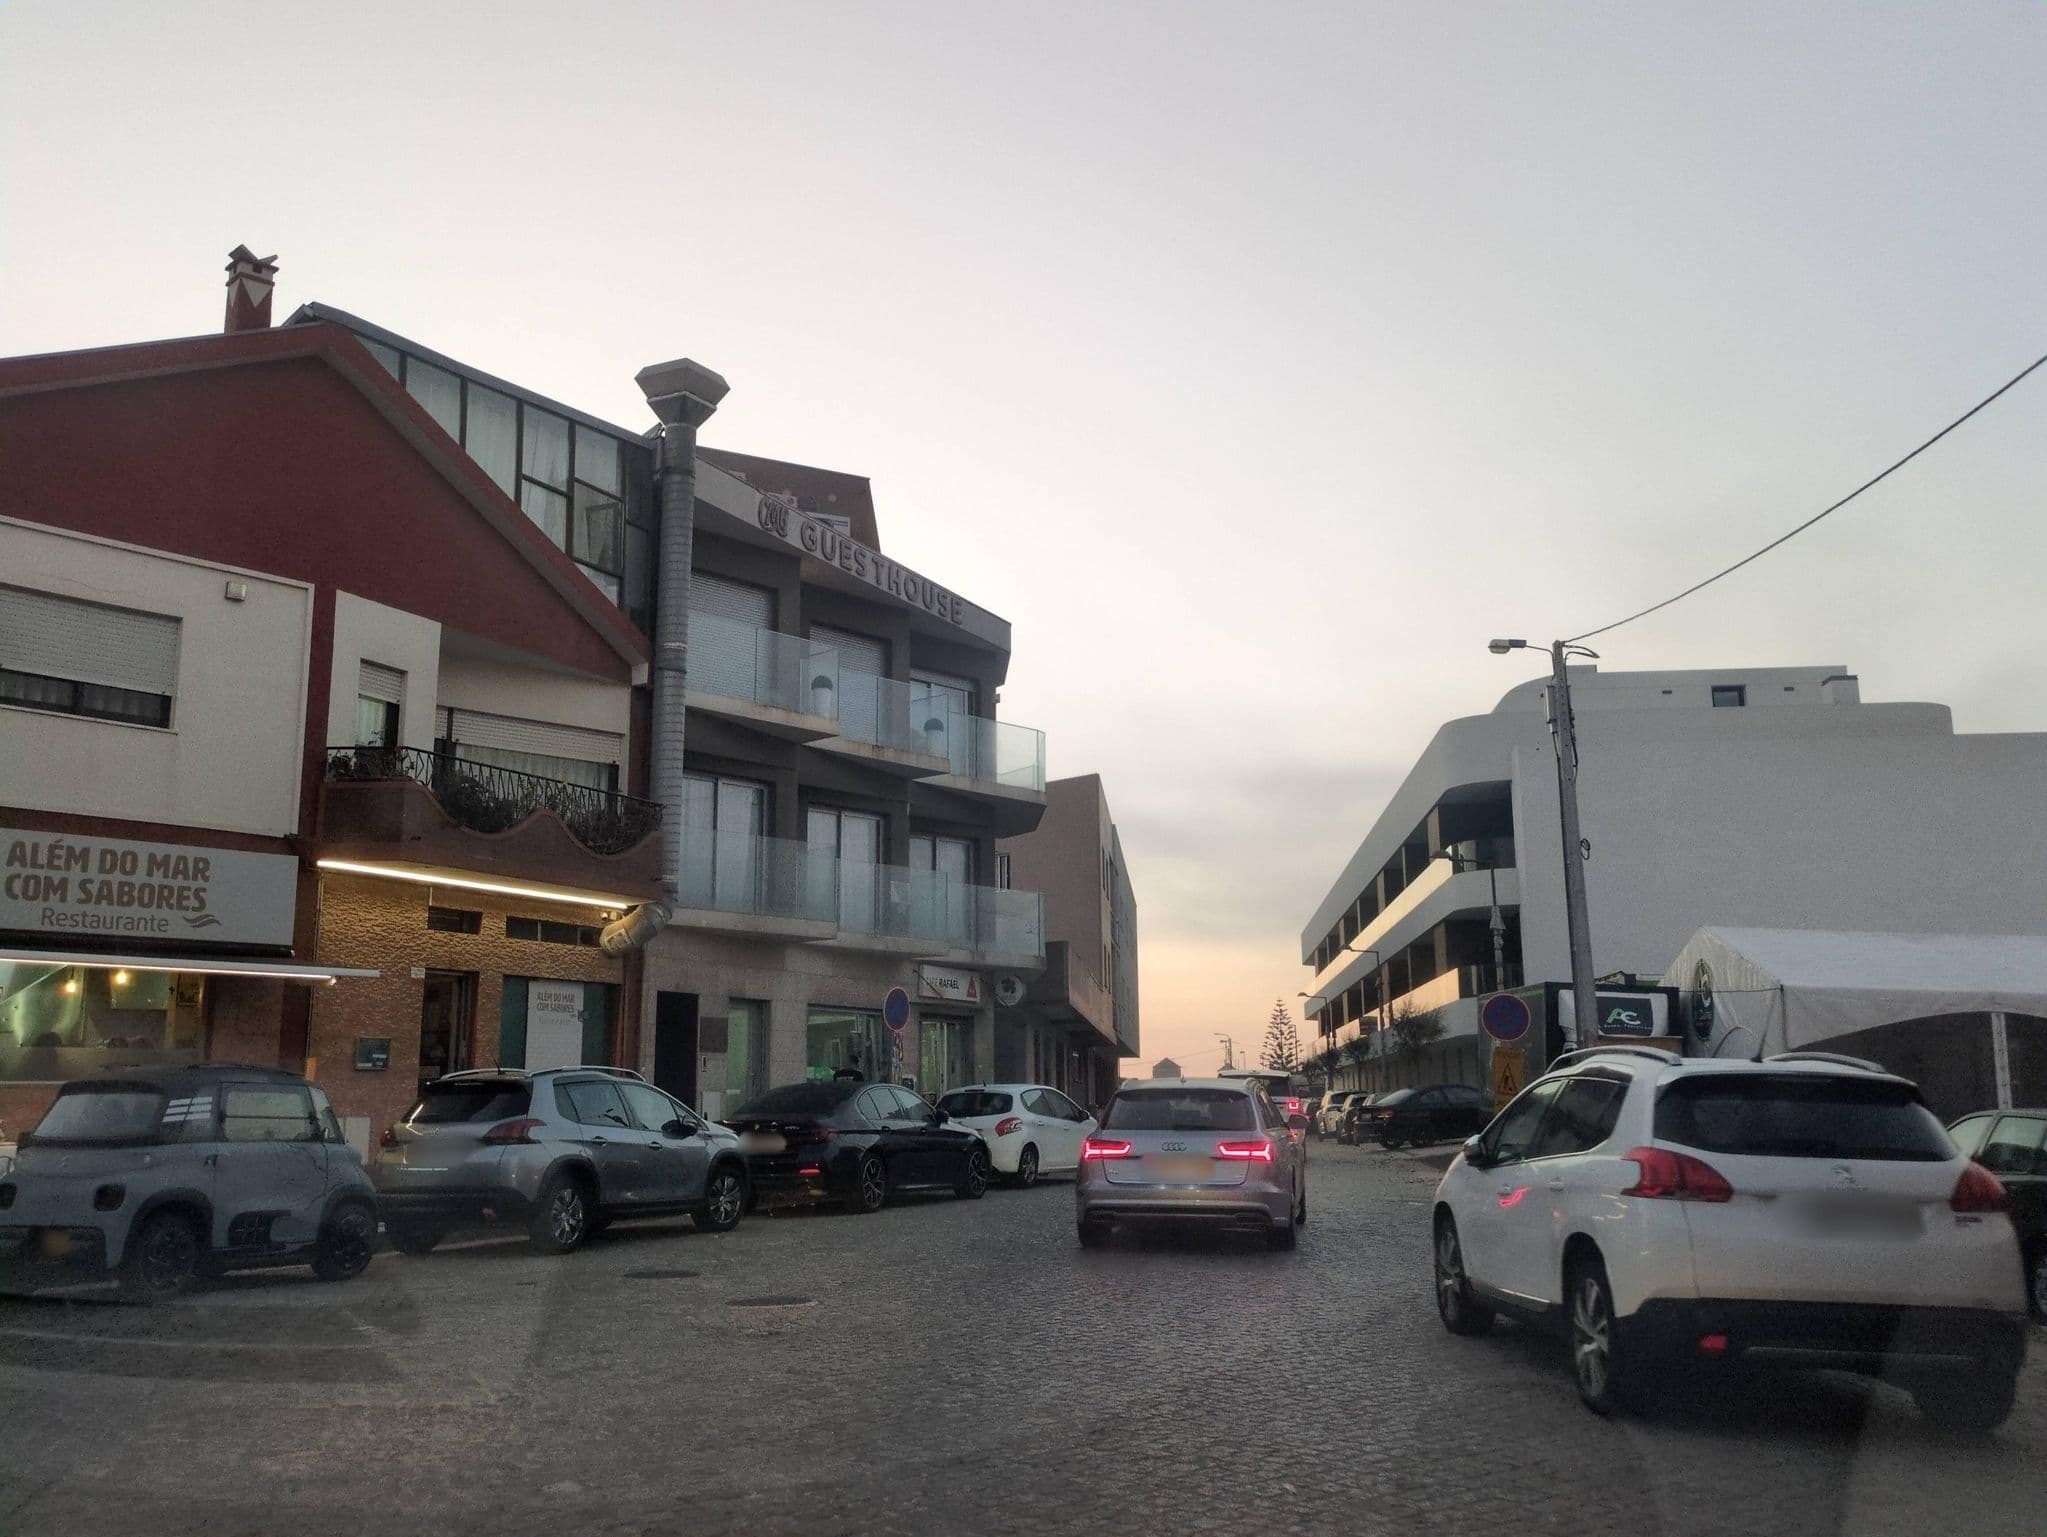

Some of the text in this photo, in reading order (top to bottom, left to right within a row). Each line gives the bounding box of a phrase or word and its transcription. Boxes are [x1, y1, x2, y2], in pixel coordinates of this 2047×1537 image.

[800, 520, 964, 626] GUESTHOUSE
[6, 838, 211, 882] ALÉM DO MAR
[5, 873, 207, 912] COM SABORES
[41, 907, 169, 932] Restaurante
[939, 978, 960, 990] RAFAEL
